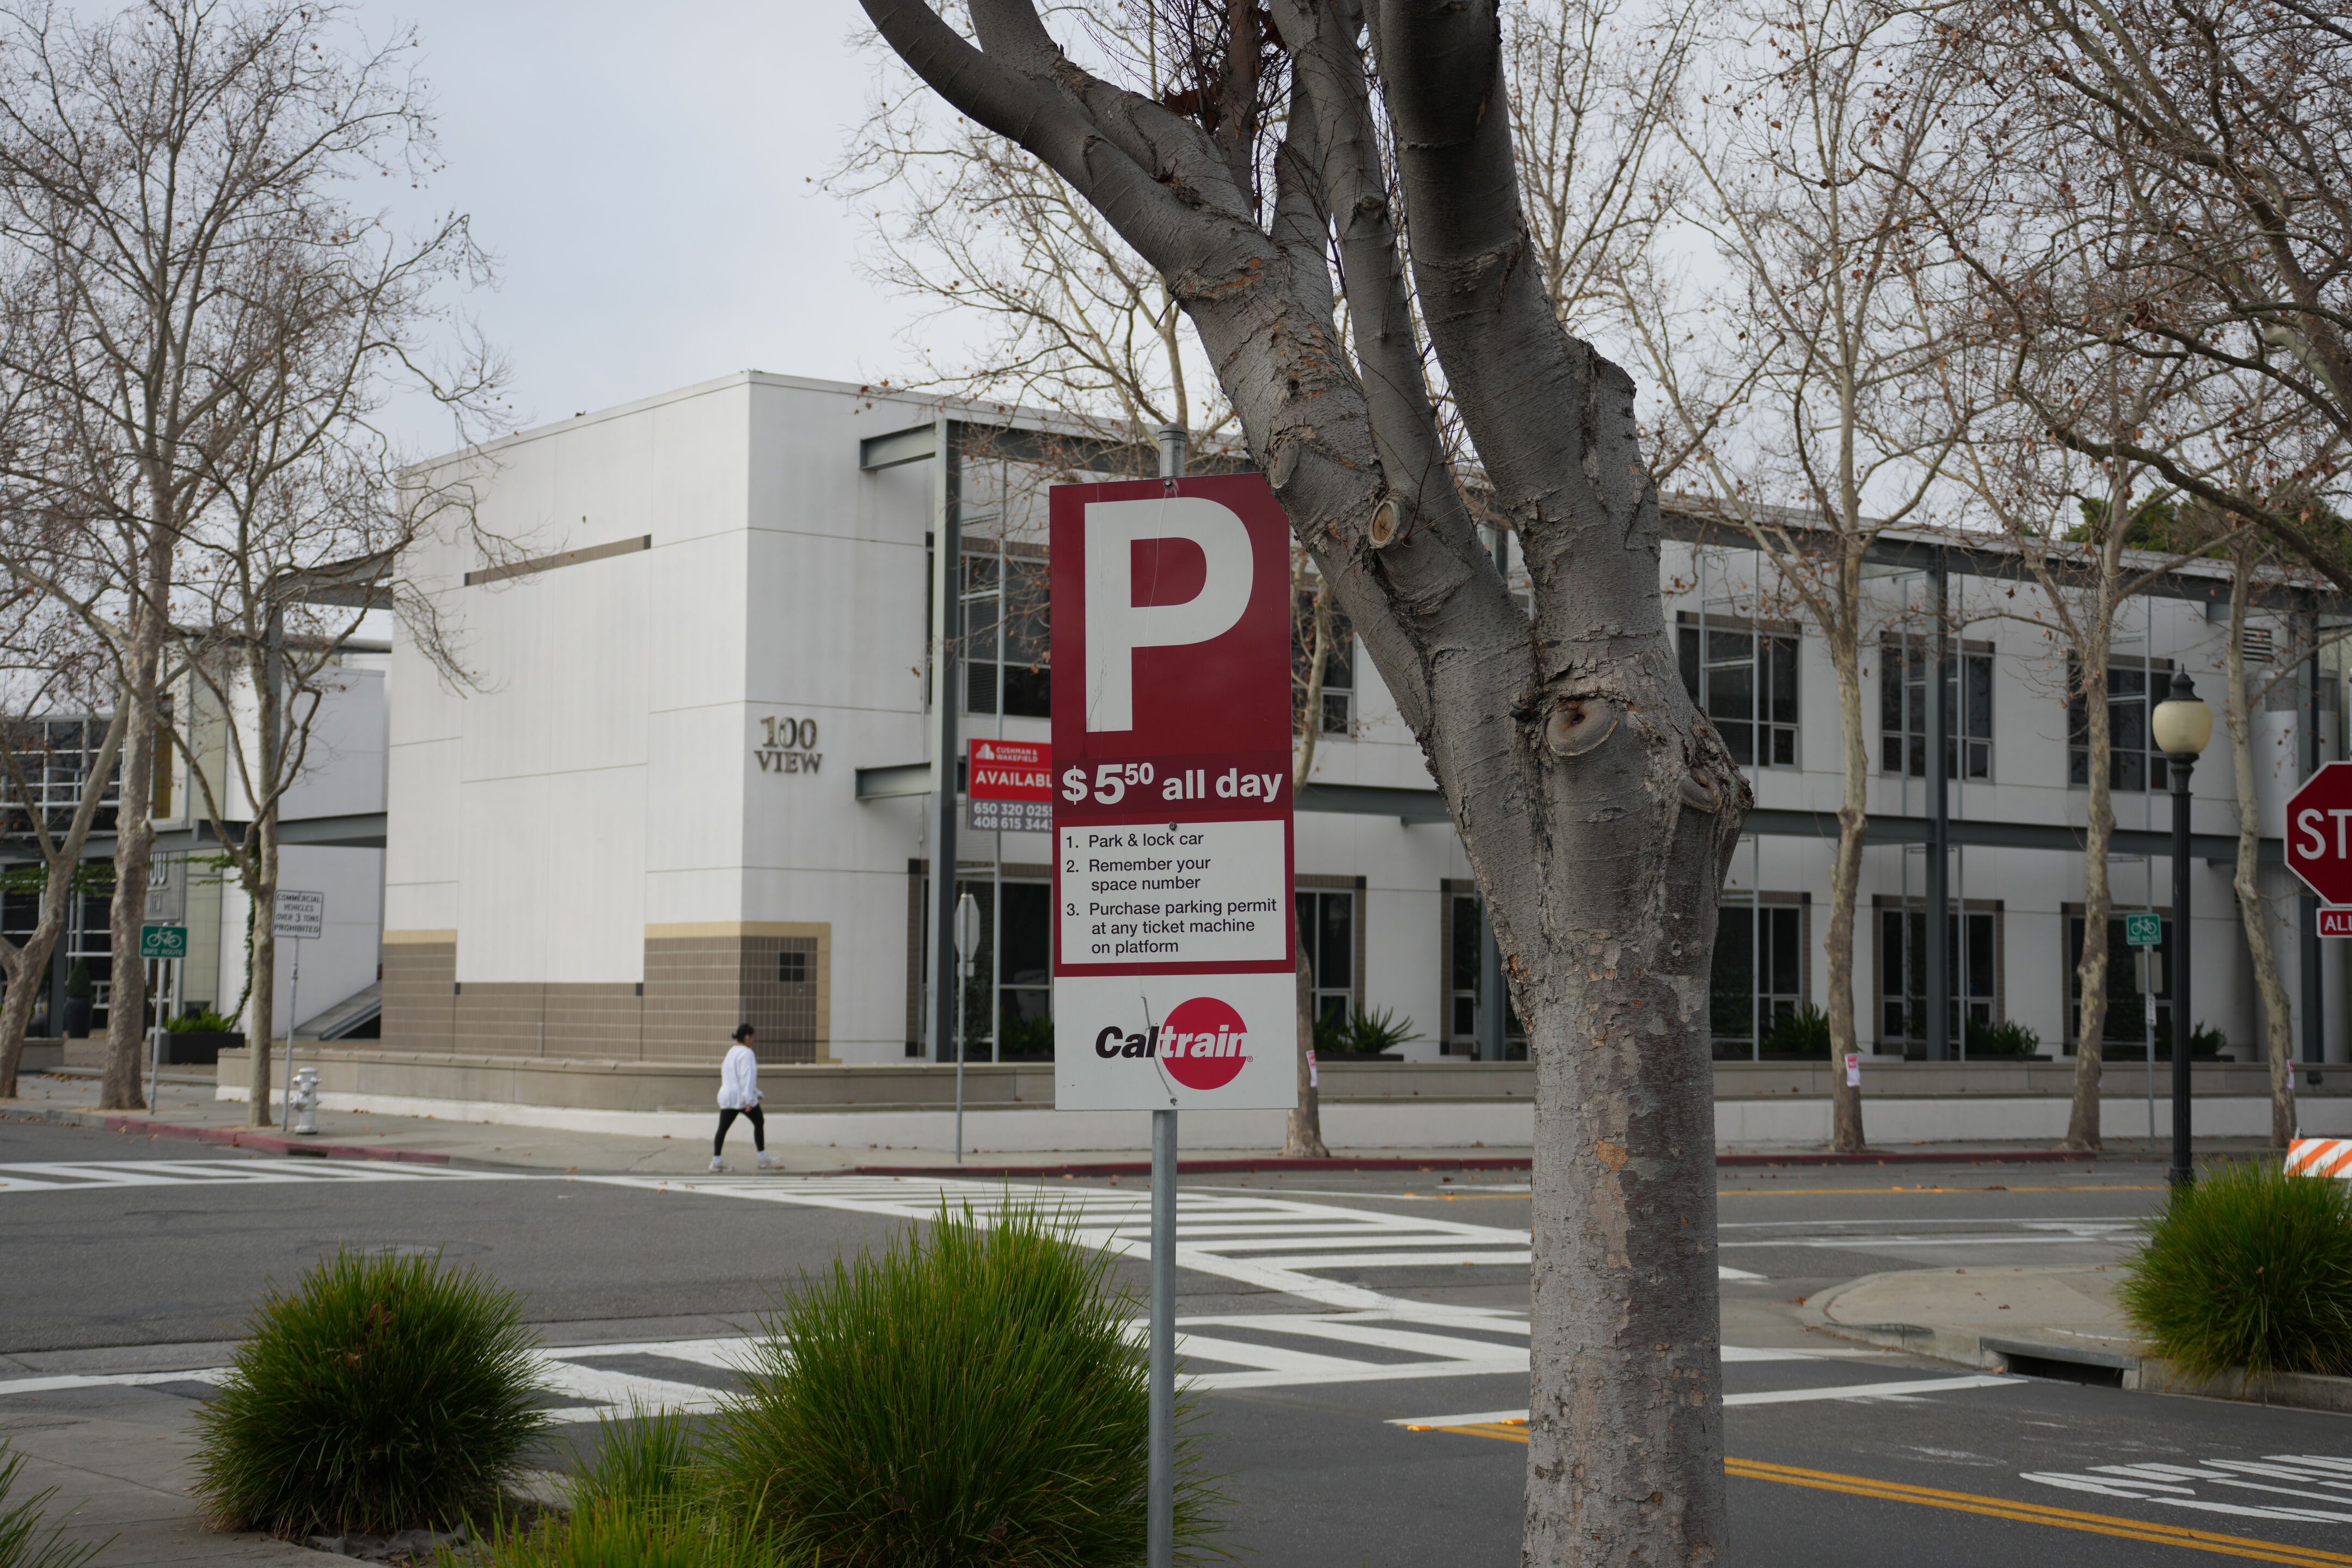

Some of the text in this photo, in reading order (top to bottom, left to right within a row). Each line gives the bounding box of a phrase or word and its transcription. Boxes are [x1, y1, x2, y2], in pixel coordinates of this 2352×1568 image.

[1085, 497, 1253, 732] P
[761, 716, 817, 750] 100
[996, 746, 1031, 755] CUSHMAN
[754, 750, 823, 774] VIEW
[997, 754, 1038, 763] WAKEFIELD
[1162, 770, 1204, 800] all
[1216, 768, 1283, 802] day
[974, 802, 997, 814] 650
[1001, 804, 1023, 816] 320
[974, 816, 997, 828] 408
[1001, 817, 1021, 829] 615
[1067, 834, 1203, 848] 1. Park & lock car
[1067, 858, 1210, 873] 2. Remember your
[1092, 876, 1200, 893] space number
[277, 895, 320, 903] COMMERCIAL
[284, 904, 314, 912] VEHICLES
[1067, 899, 1276, 916] 3. Purchase parking permit
[295, 914, 301, 922] 3
[274, 923, 318, 933] PROHIBITED
[1092, 919, 1254, 937] at any ticket machine
[1092, 940, 1178, 956] on platform
[1095, 1025, 1247, 1058] Caltrain
